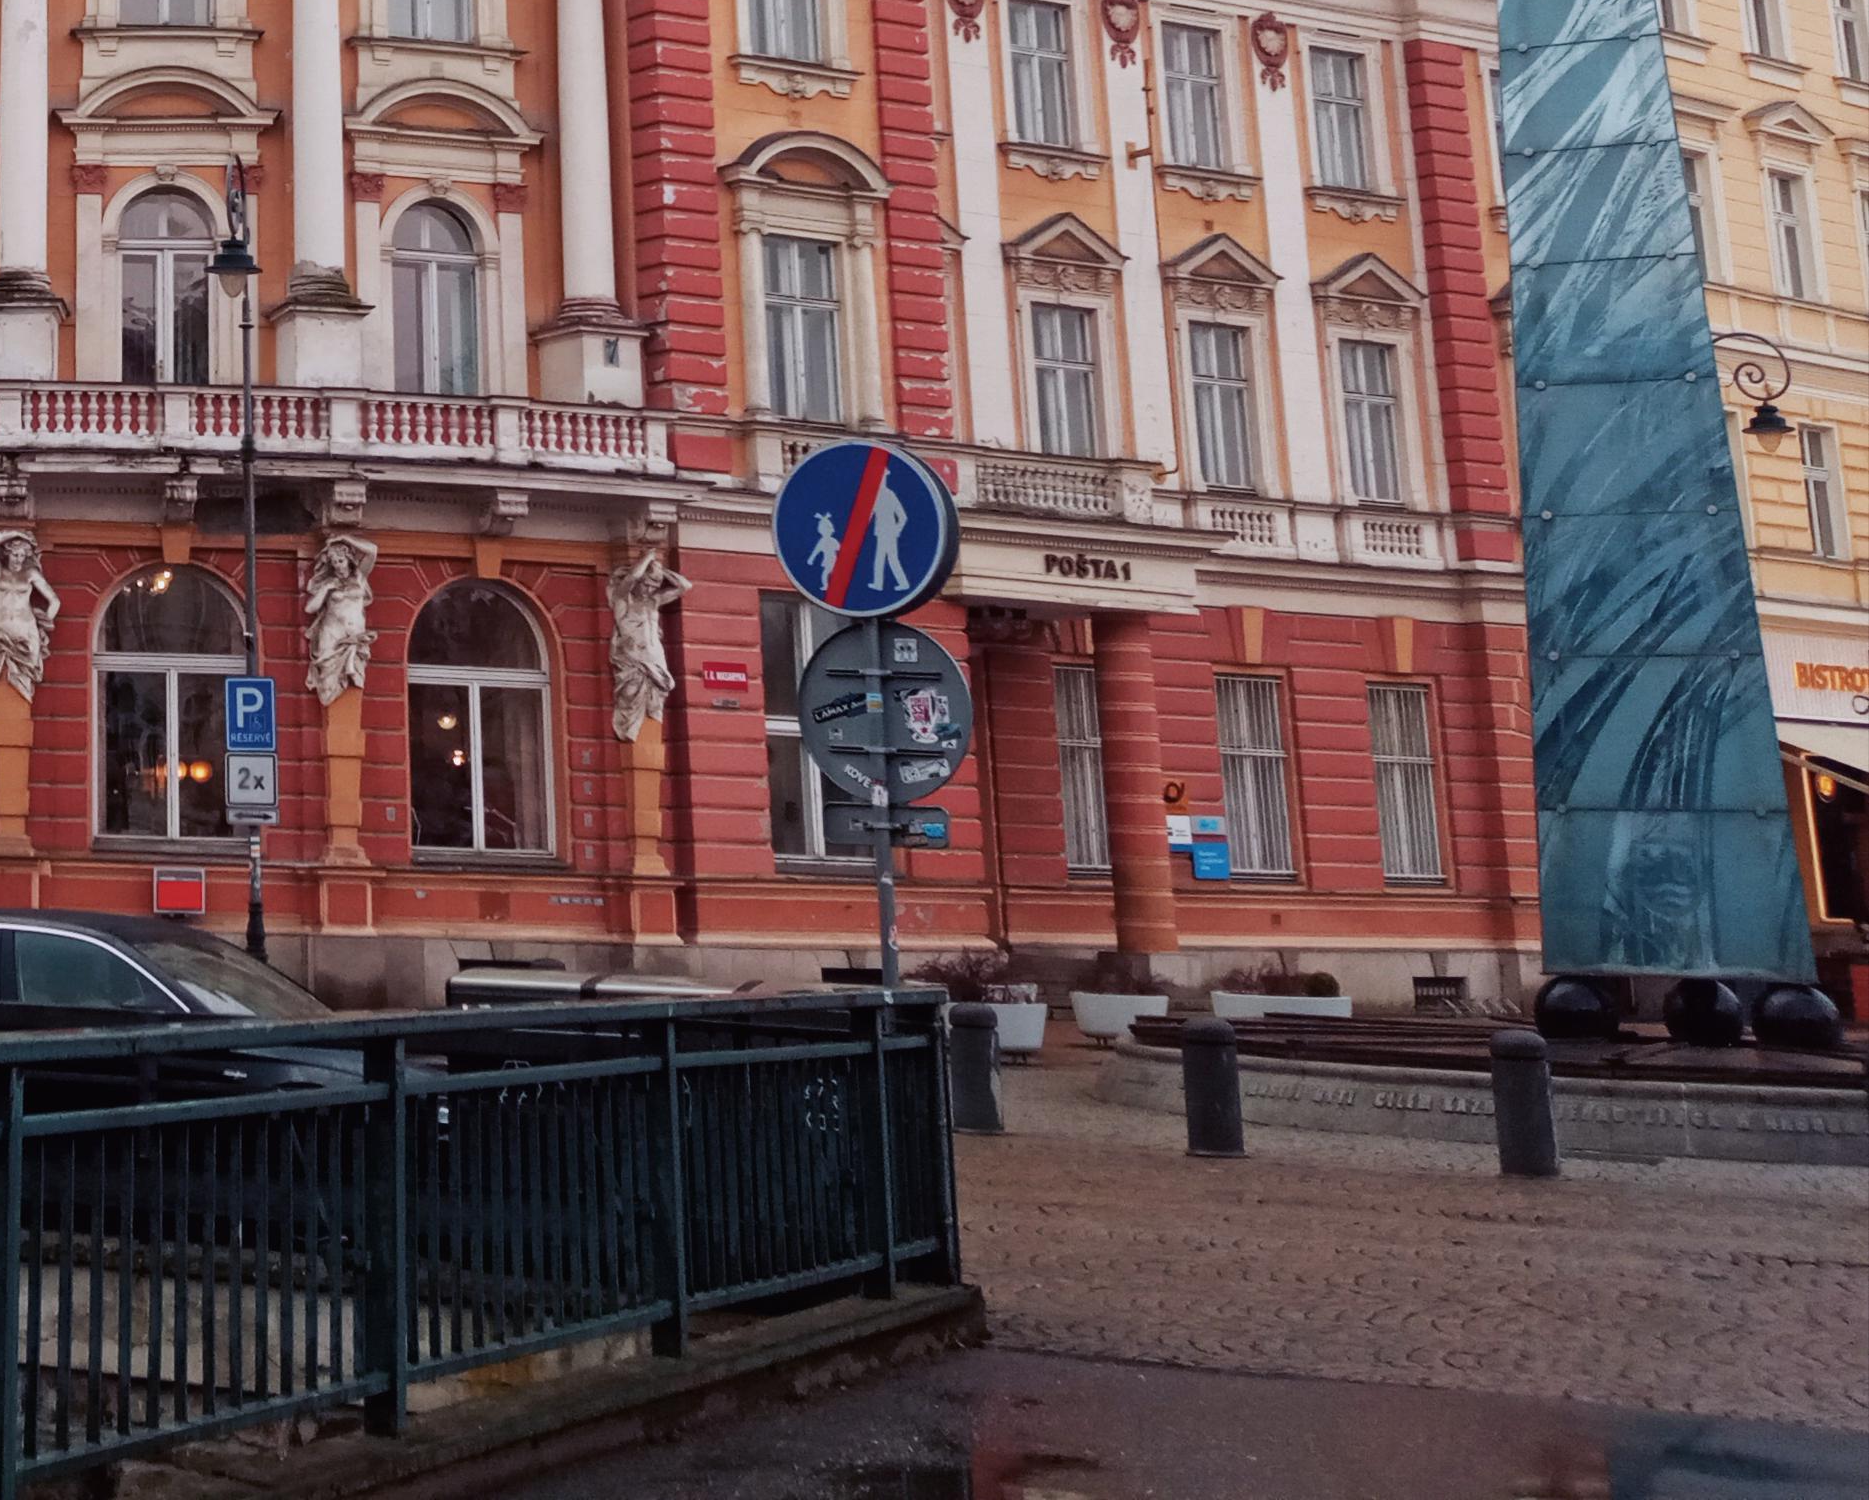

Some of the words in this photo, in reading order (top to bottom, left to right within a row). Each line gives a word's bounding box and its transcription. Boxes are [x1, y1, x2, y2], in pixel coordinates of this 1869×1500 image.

[1045, 553, 1119, 579] POŠTA
[1121, 561, 1131, 581] 1
[236, 687, 263, 728] P
[237, 767, 265, 790] 2x
